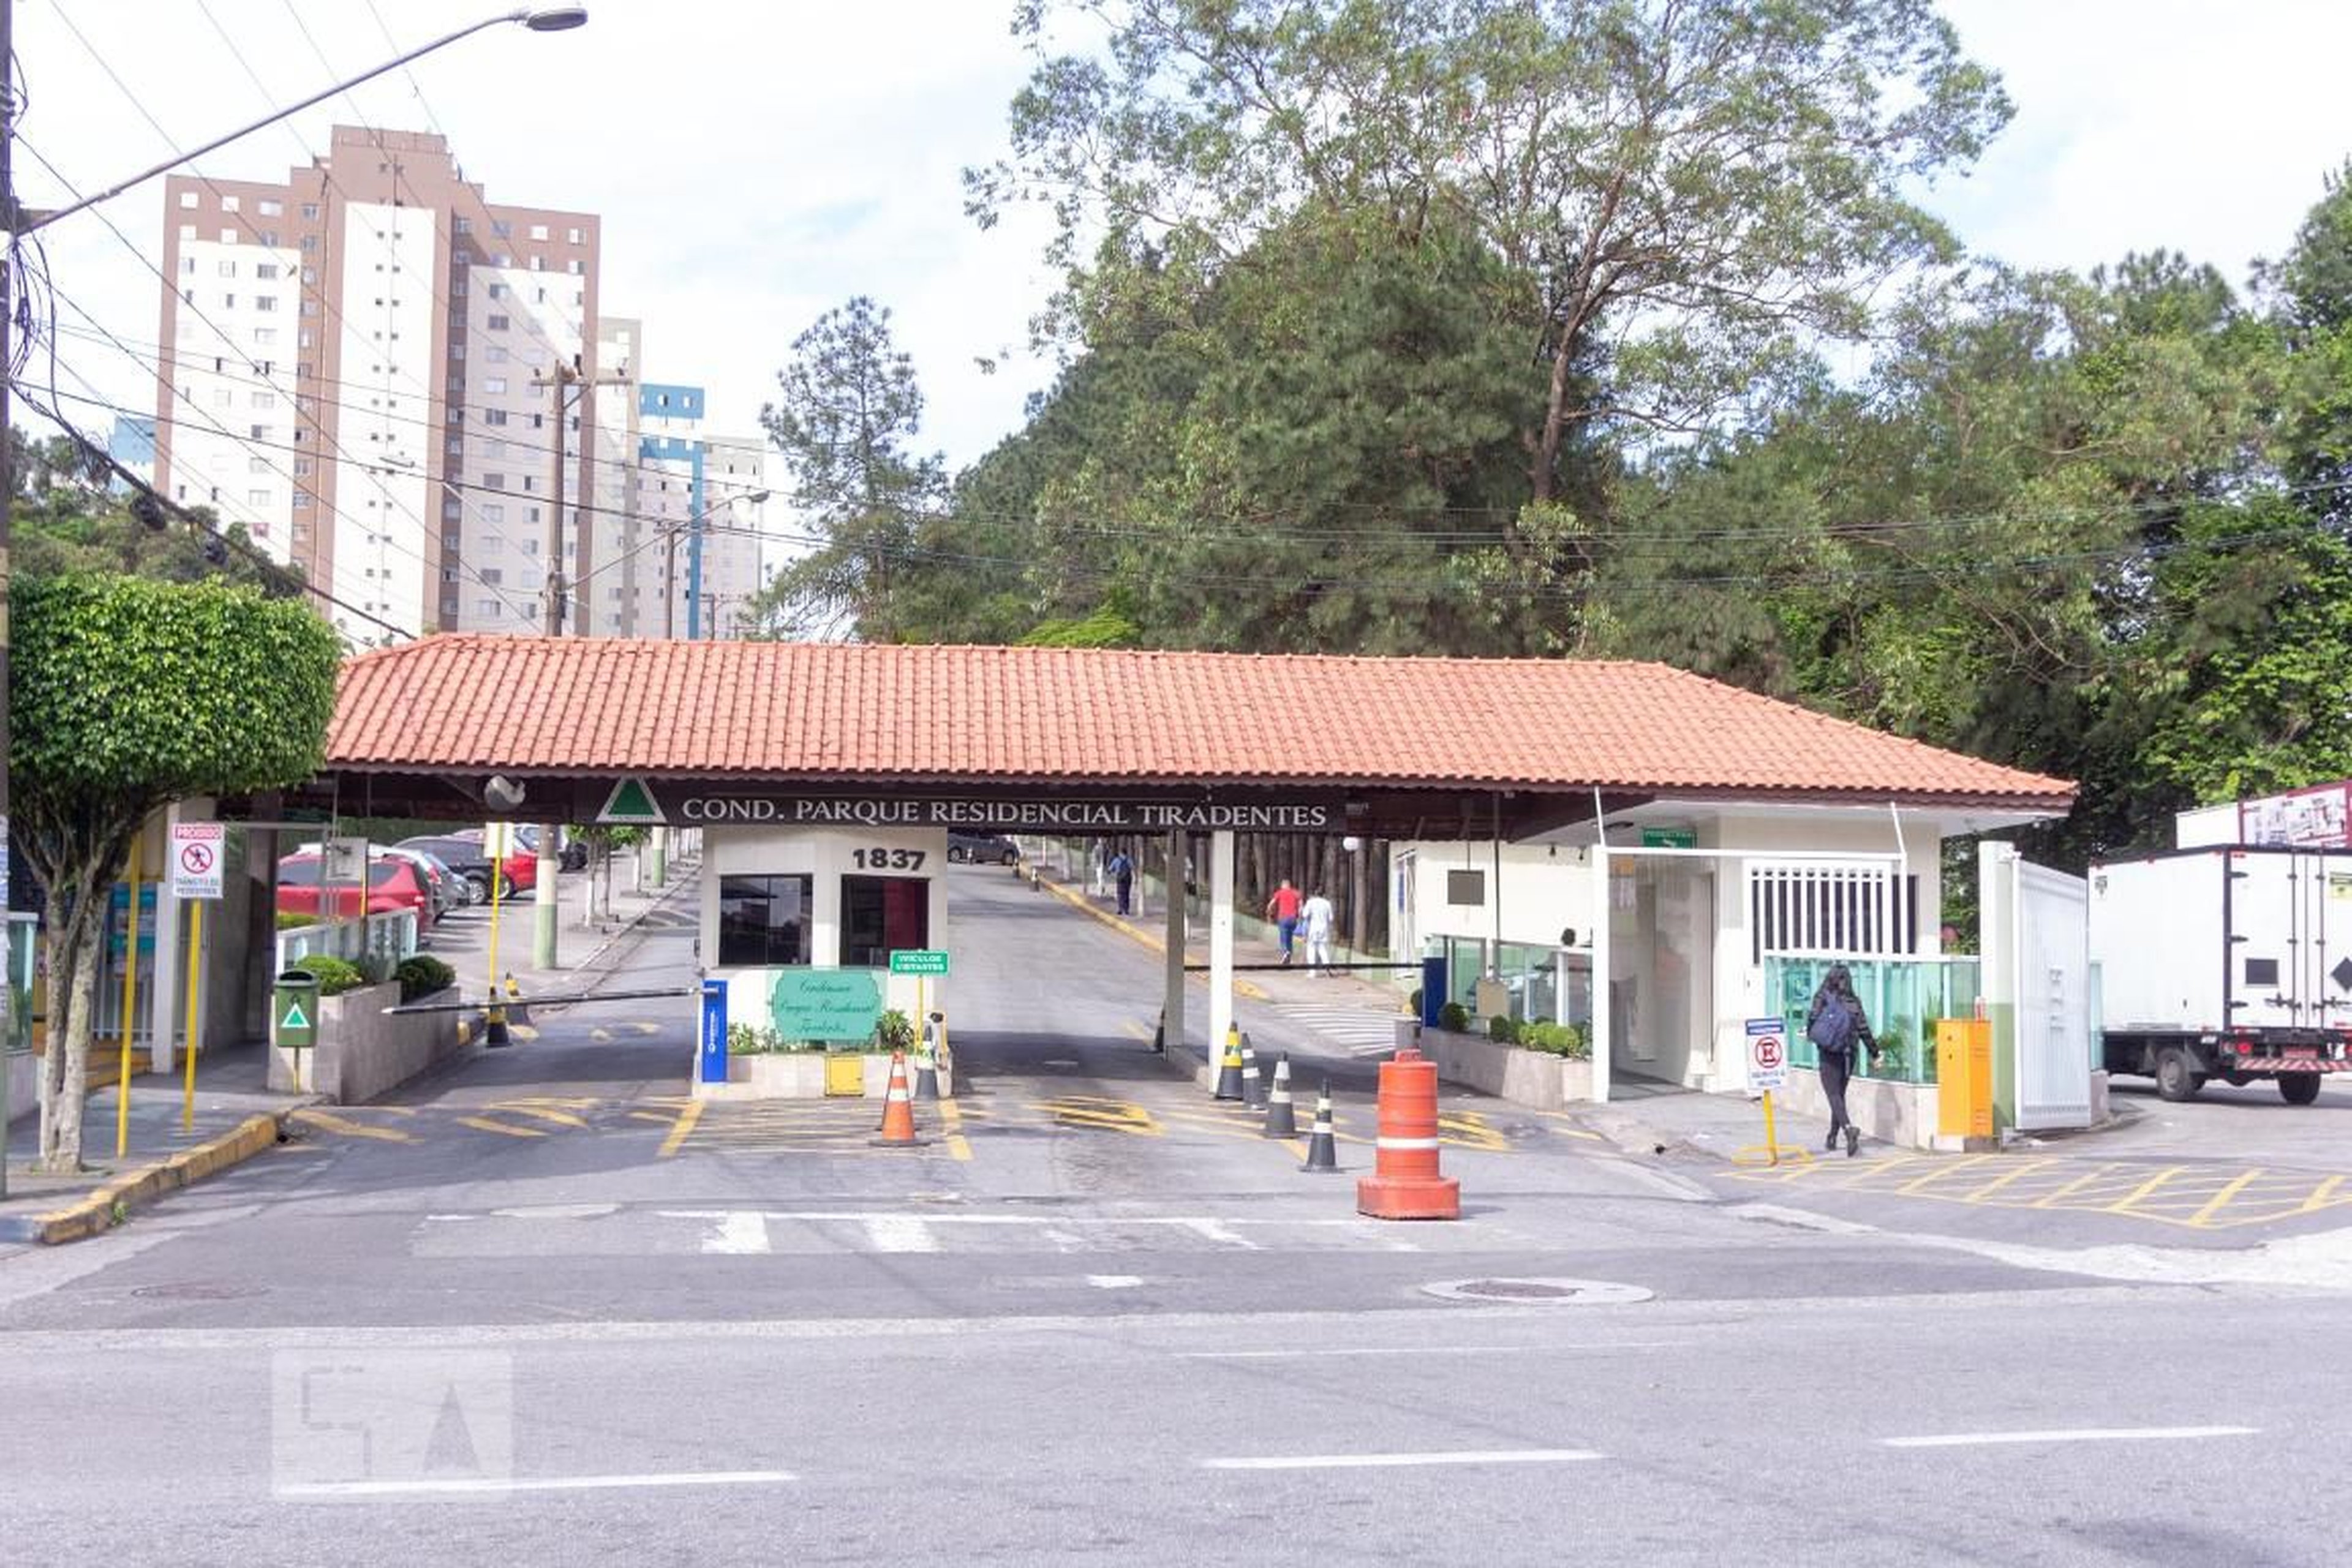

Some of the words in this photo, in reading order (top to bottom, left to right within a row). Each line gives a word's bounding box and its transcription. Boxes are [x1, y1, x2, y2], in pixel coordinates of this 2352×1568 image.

[682, 799, 785, 820] COND.
[795, 801, 918, 825] PARQUE
[930, 801, 1128, 824] RESIDENCIAL
[1137, 805, 1326, 827] TIRADENTES
[852, 848, 925, 871] 1837
